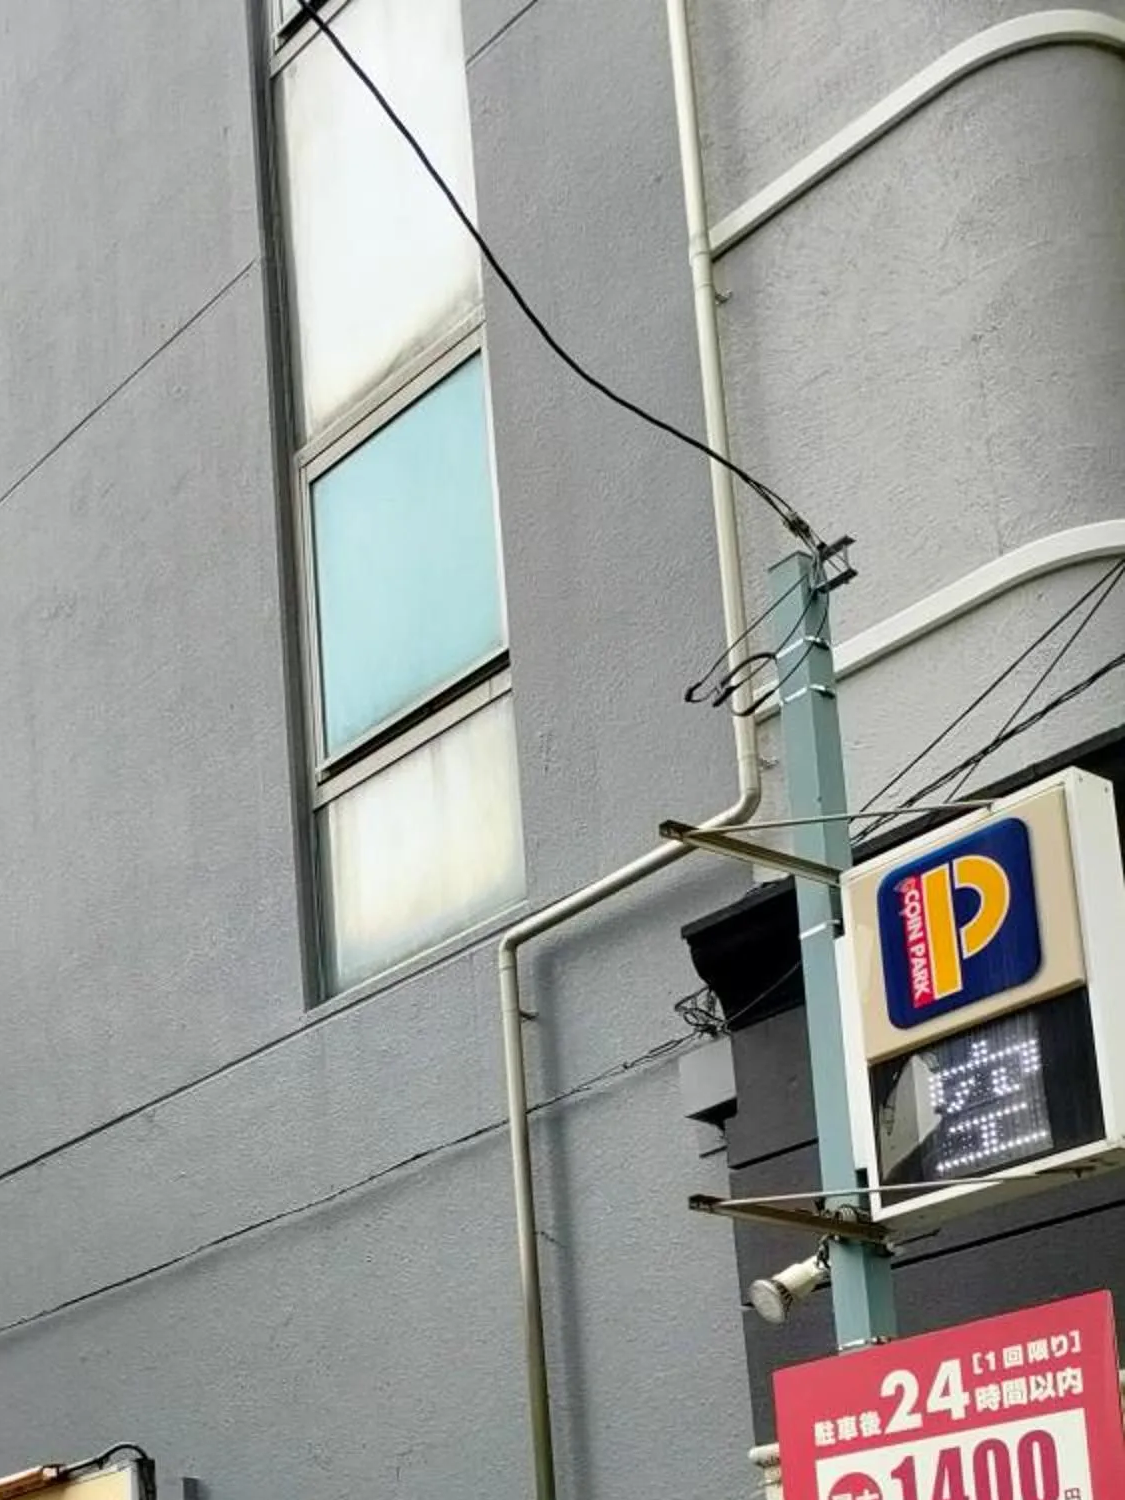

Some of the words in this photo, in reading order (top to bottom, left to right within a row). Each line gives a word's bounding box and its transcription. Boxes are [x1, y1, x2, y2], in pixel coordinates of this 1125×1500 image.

[904, 888, 925, 942] COIN
[910, 943, 931, 998] PARK
[881, 1358, 970, 1434] 24
[975, 1367, 1085, 1413] 時間以内
